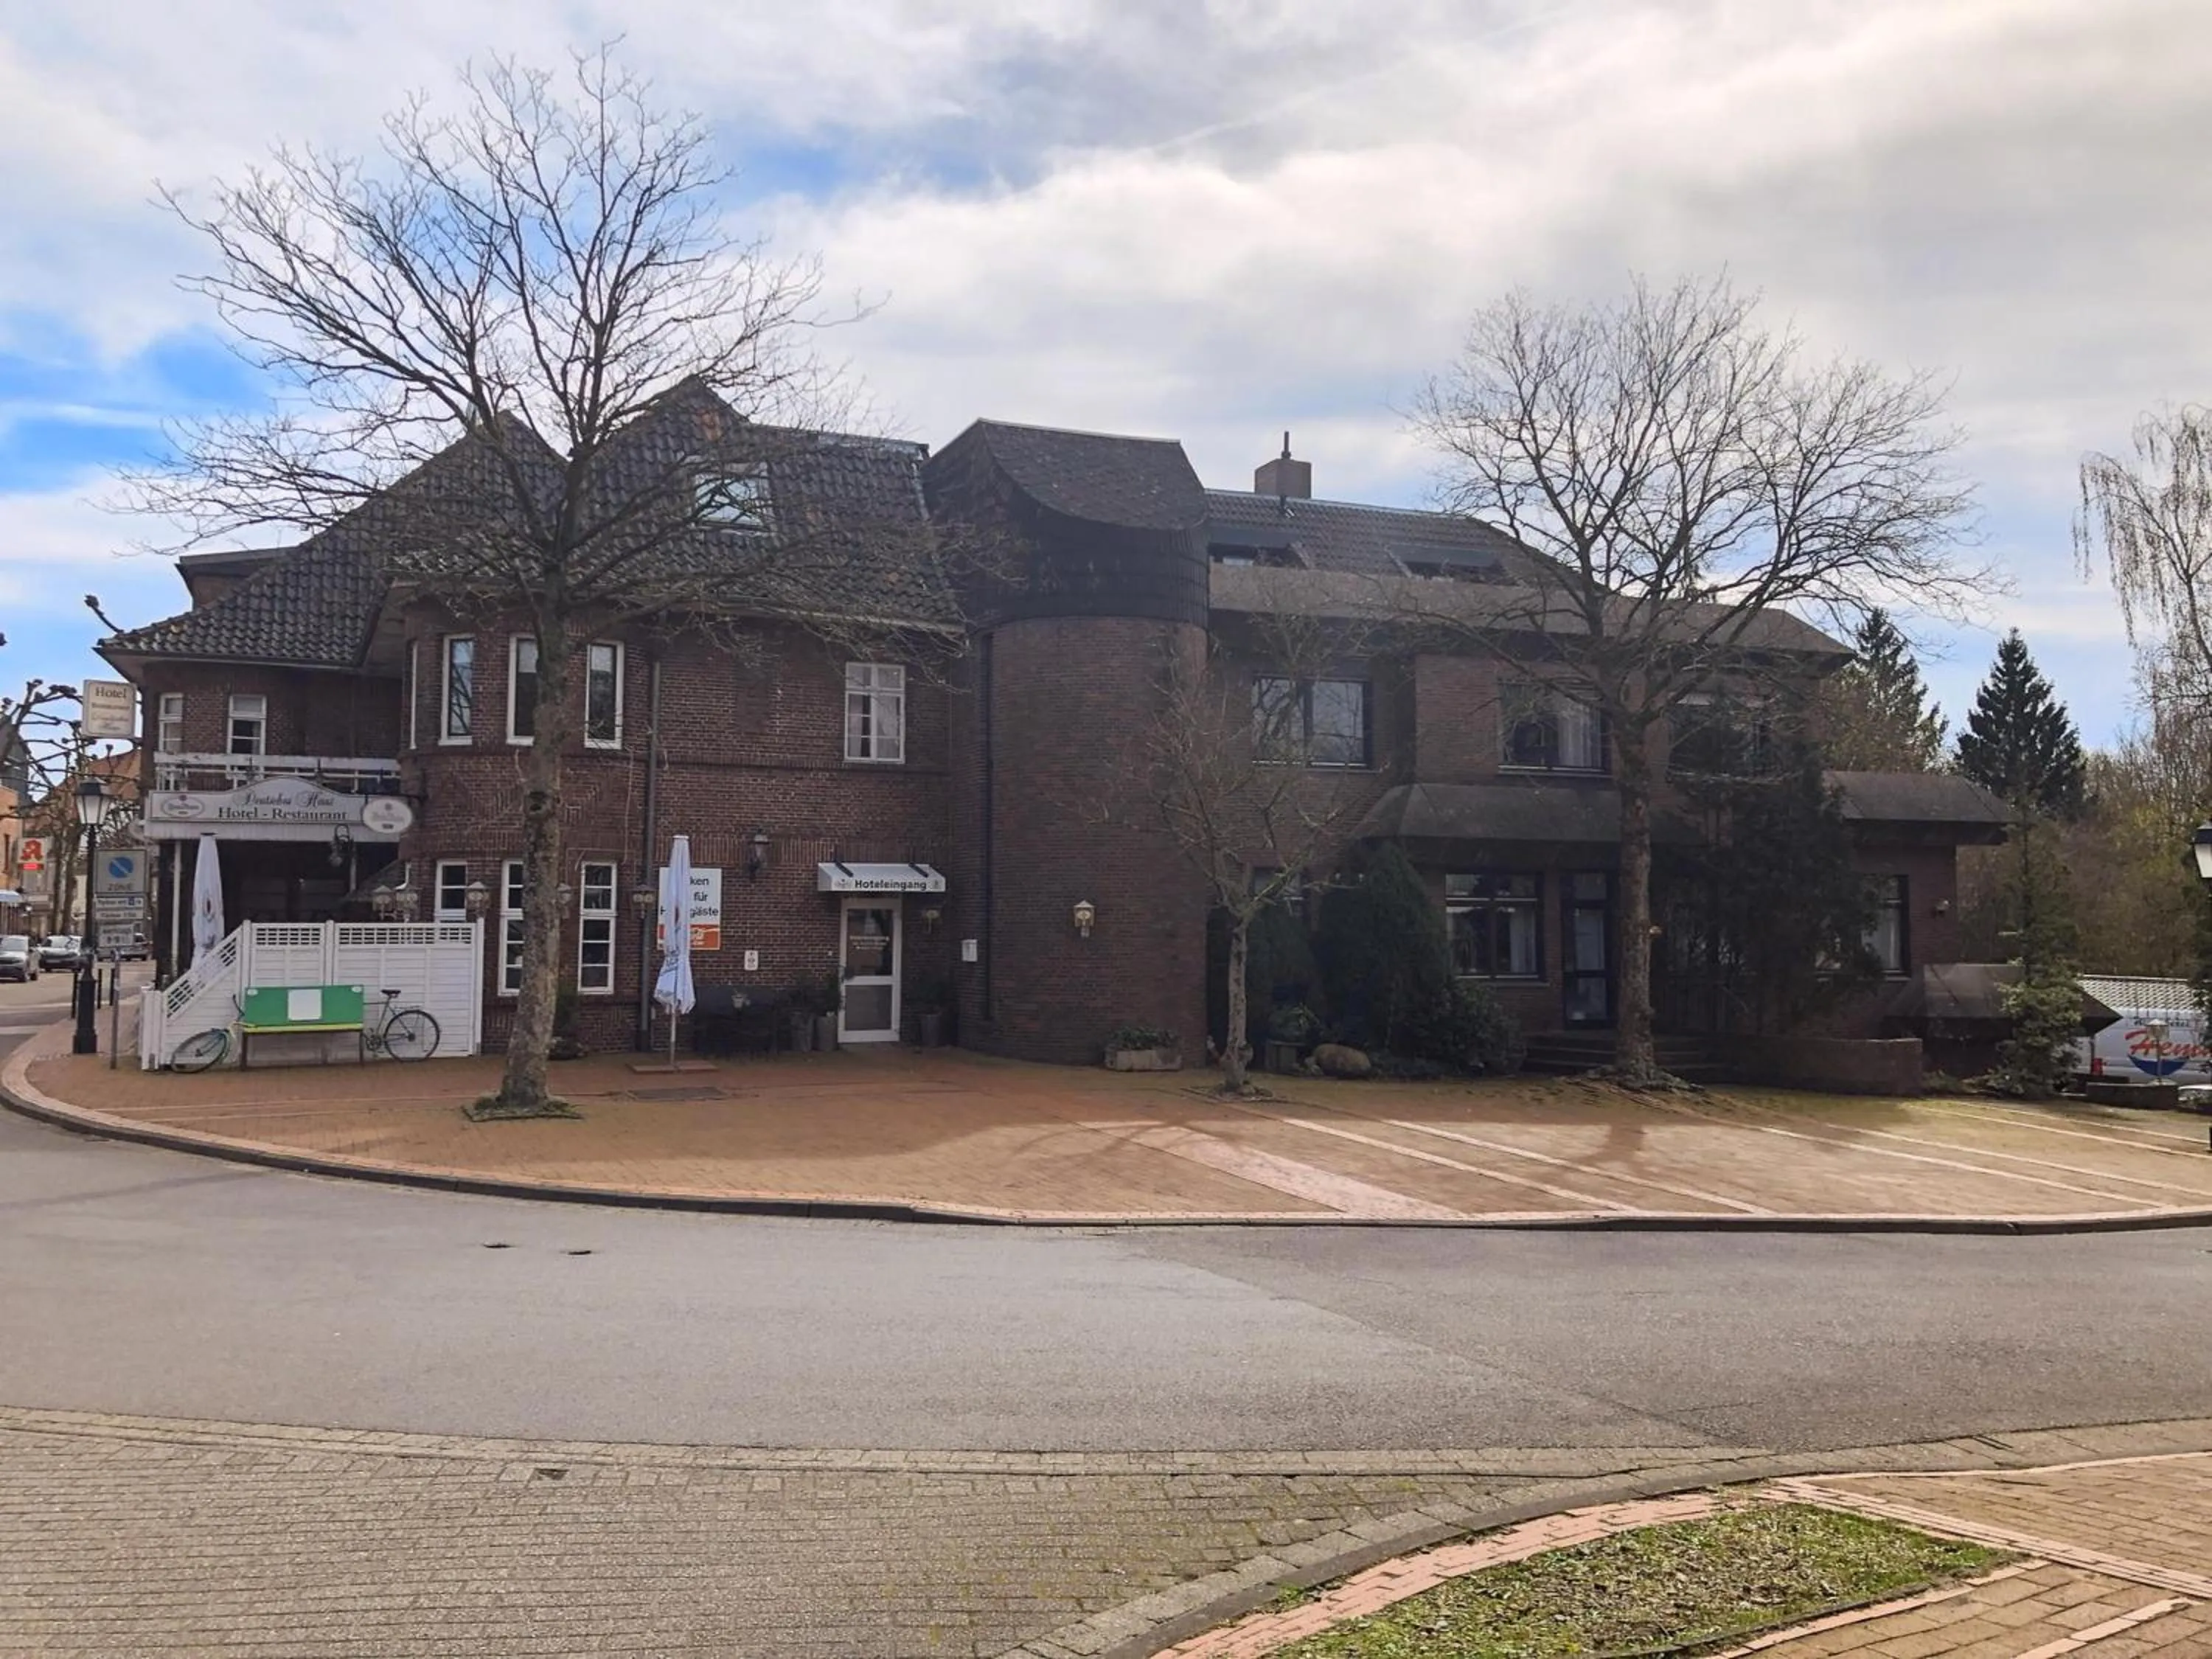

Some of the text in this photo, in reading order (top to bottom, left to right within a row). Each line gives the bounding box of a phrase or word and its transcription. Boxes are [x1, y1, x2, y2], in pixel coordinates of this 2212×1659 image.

[95, 686, 128, 698] Hotel
[218, 807, 258, 819] Hotel
[272, 807, 348, 821] Restaurant
[689, 876, 709, 886] ken
[855, 880, 927, 891] Hoteleingang
[694, 891, 709, 901] für
